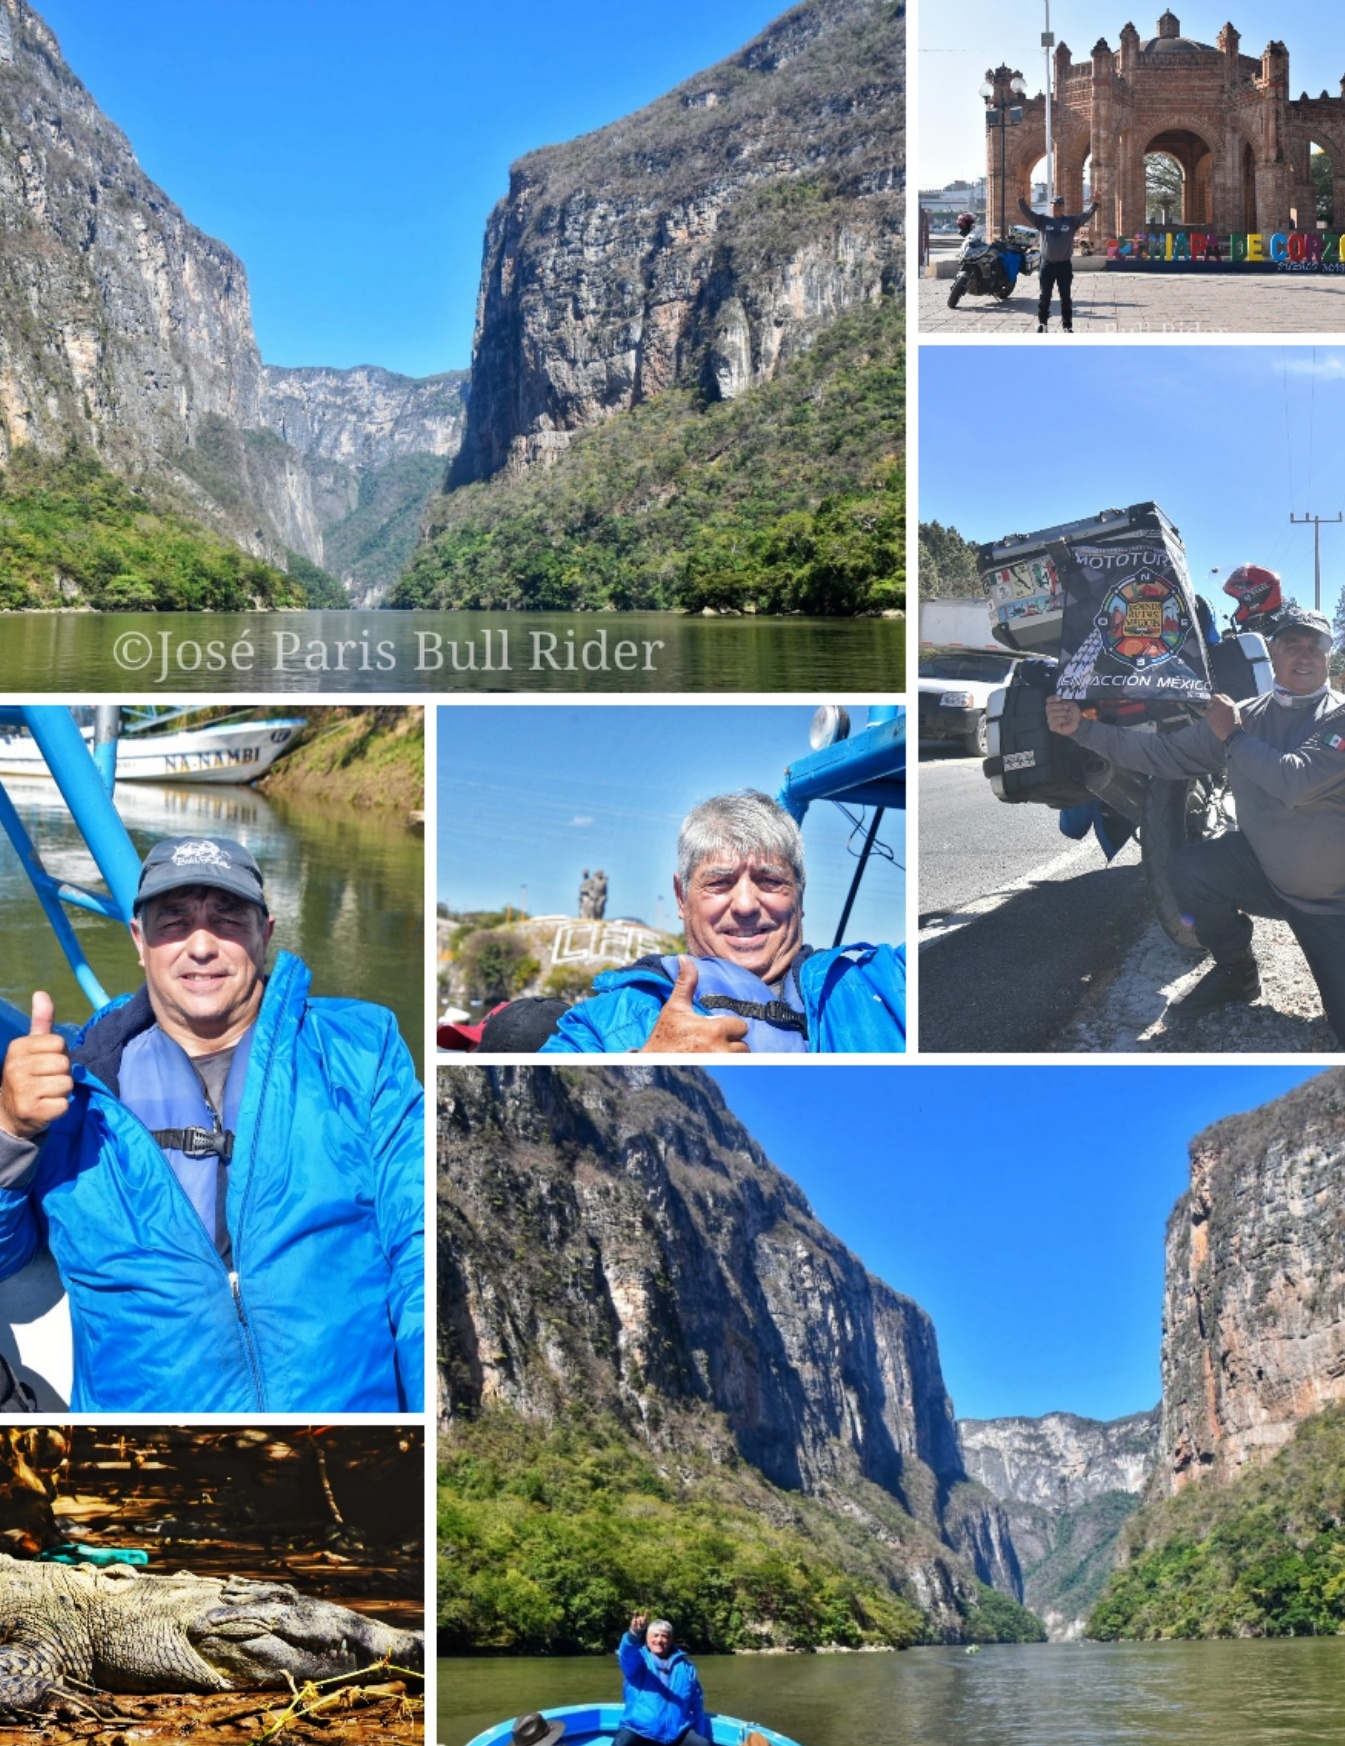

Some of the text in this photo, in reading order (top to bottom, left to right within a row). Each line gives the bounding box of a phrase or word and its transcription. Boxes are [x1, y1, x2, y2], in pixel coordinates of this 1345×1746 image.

[1230, 233, 1264, 261] DE
[1140, 573, 1150, 582] N
[1090, 672, 1150, 687] ACCIÓN
